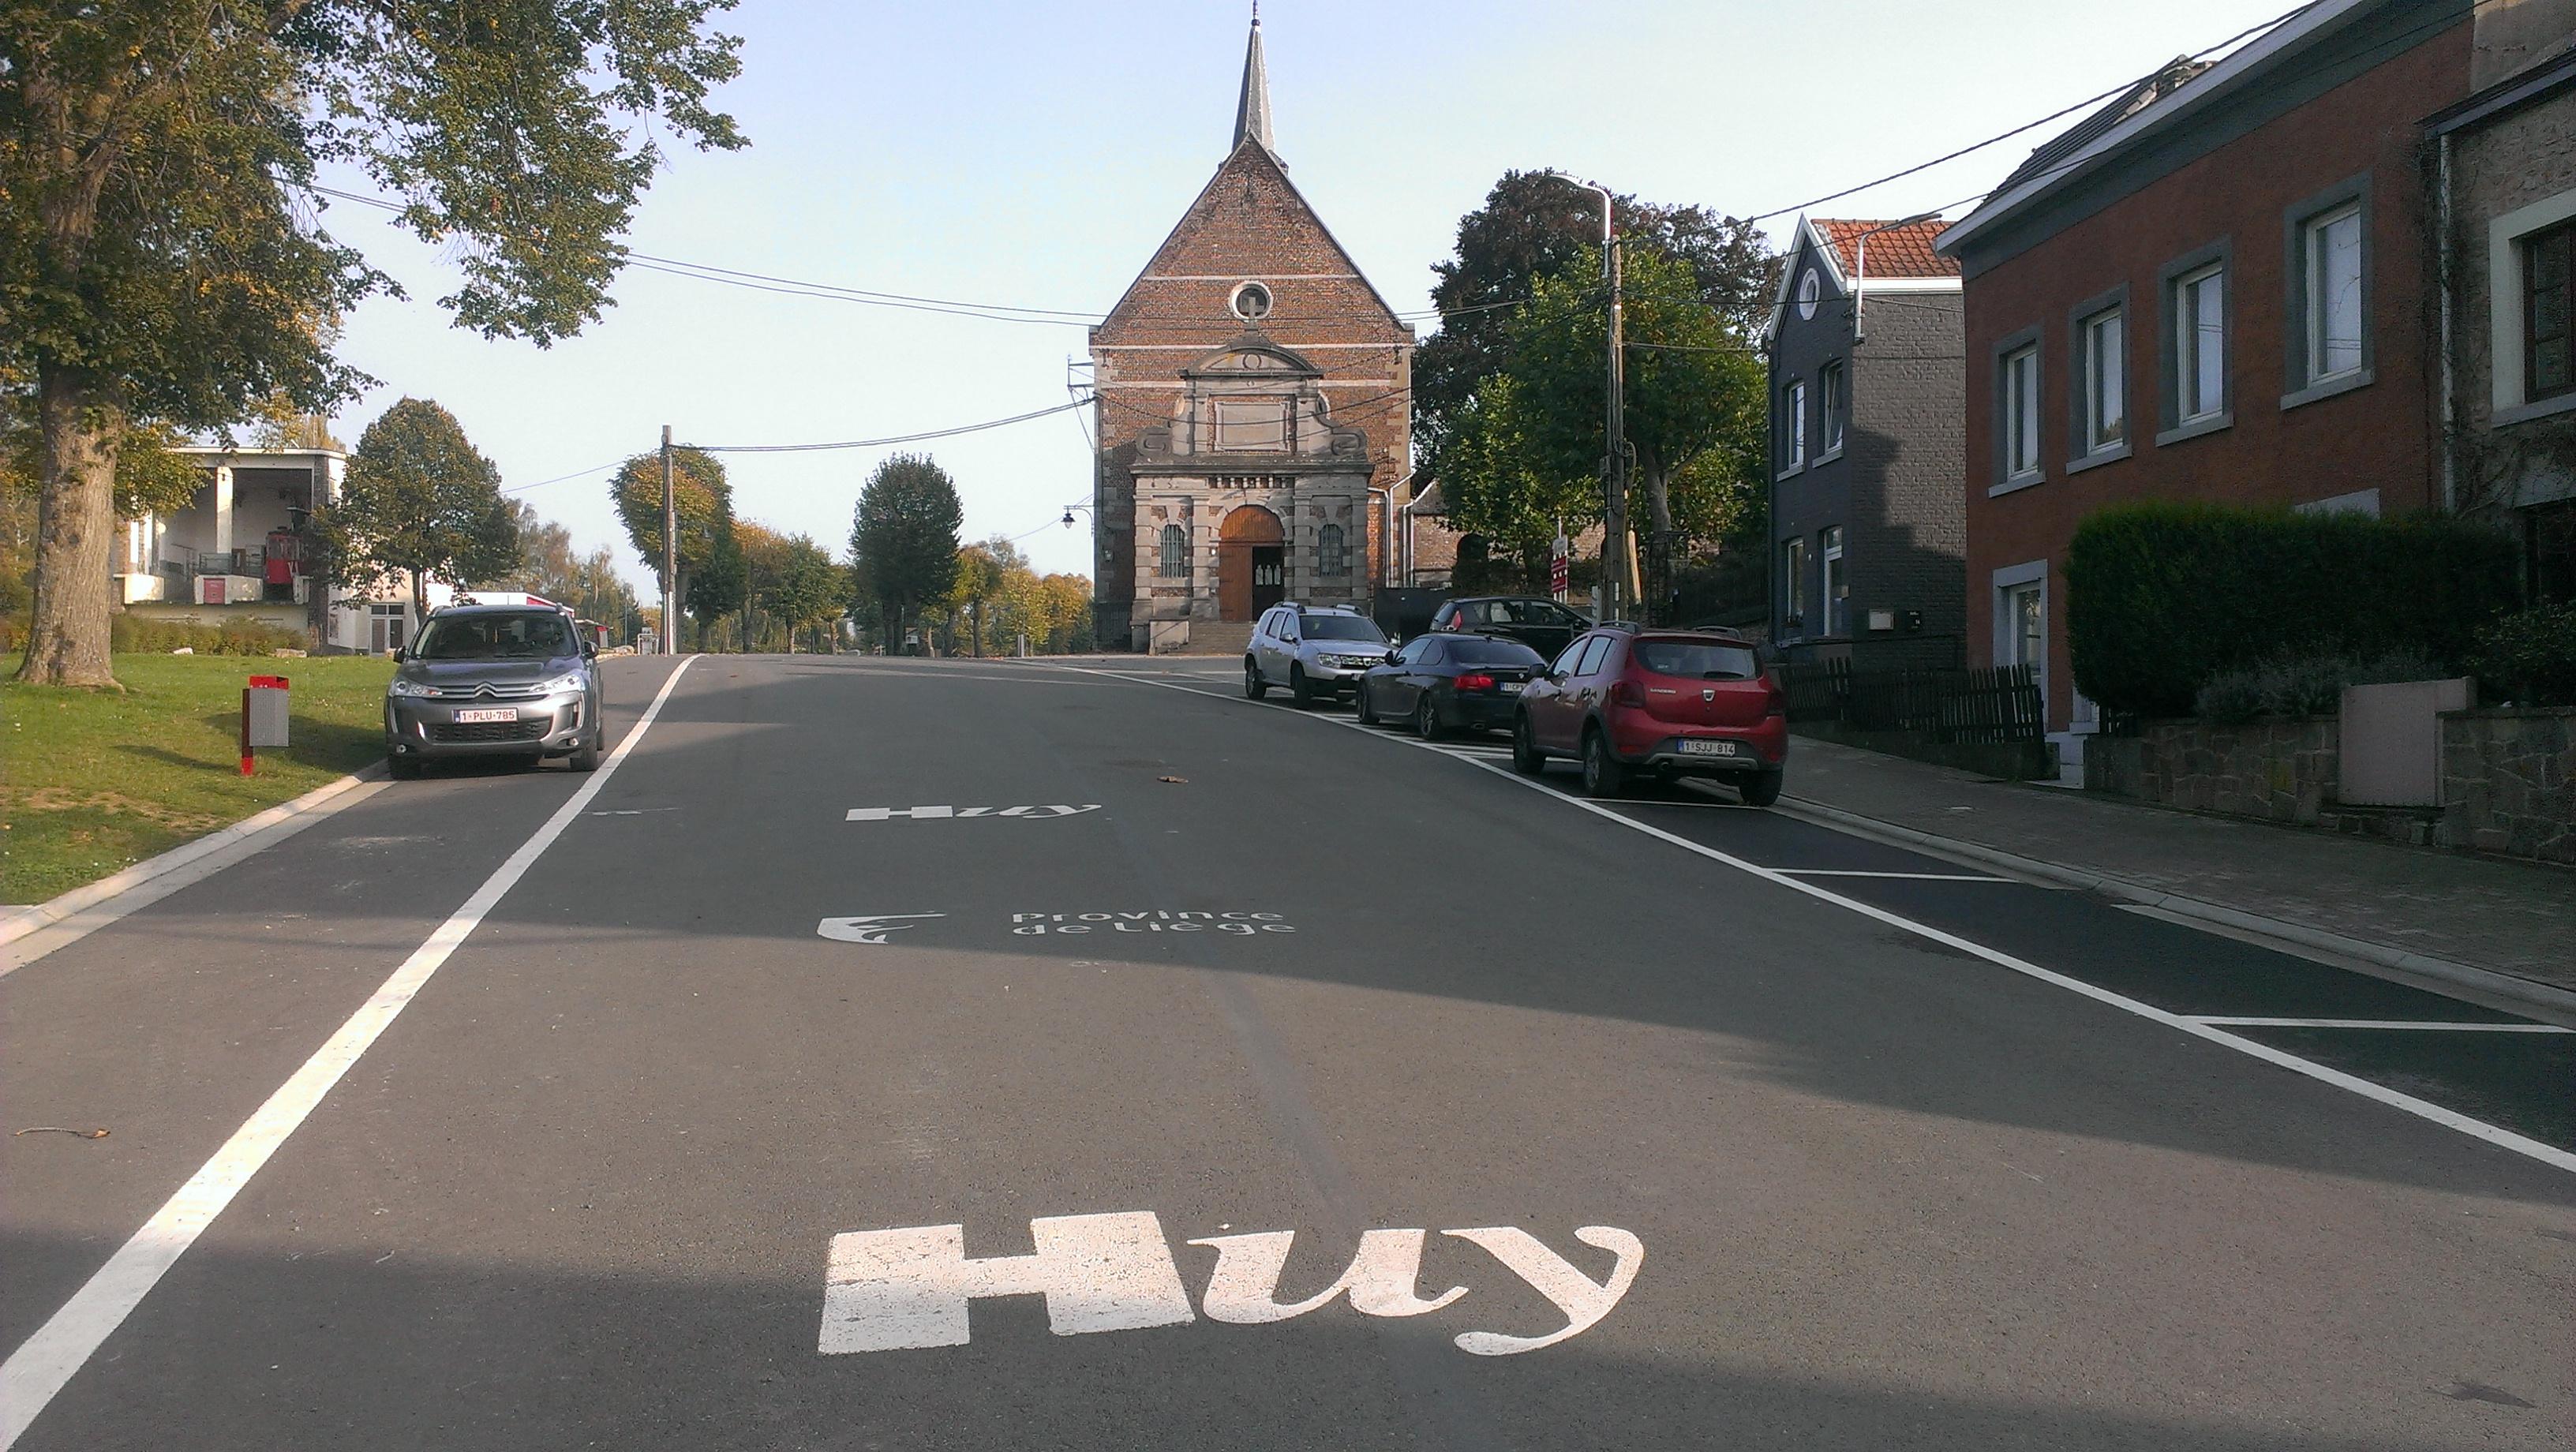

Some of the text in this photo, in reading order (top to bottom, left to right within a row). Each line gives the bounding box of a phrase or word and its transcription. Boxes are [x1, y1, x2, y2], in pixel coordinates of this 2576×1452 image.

[845, 805, 1102, 821] Huy
[1013, 921, 1296, 935] de Liège
[817, 1211, 1645, 1357] Huy
